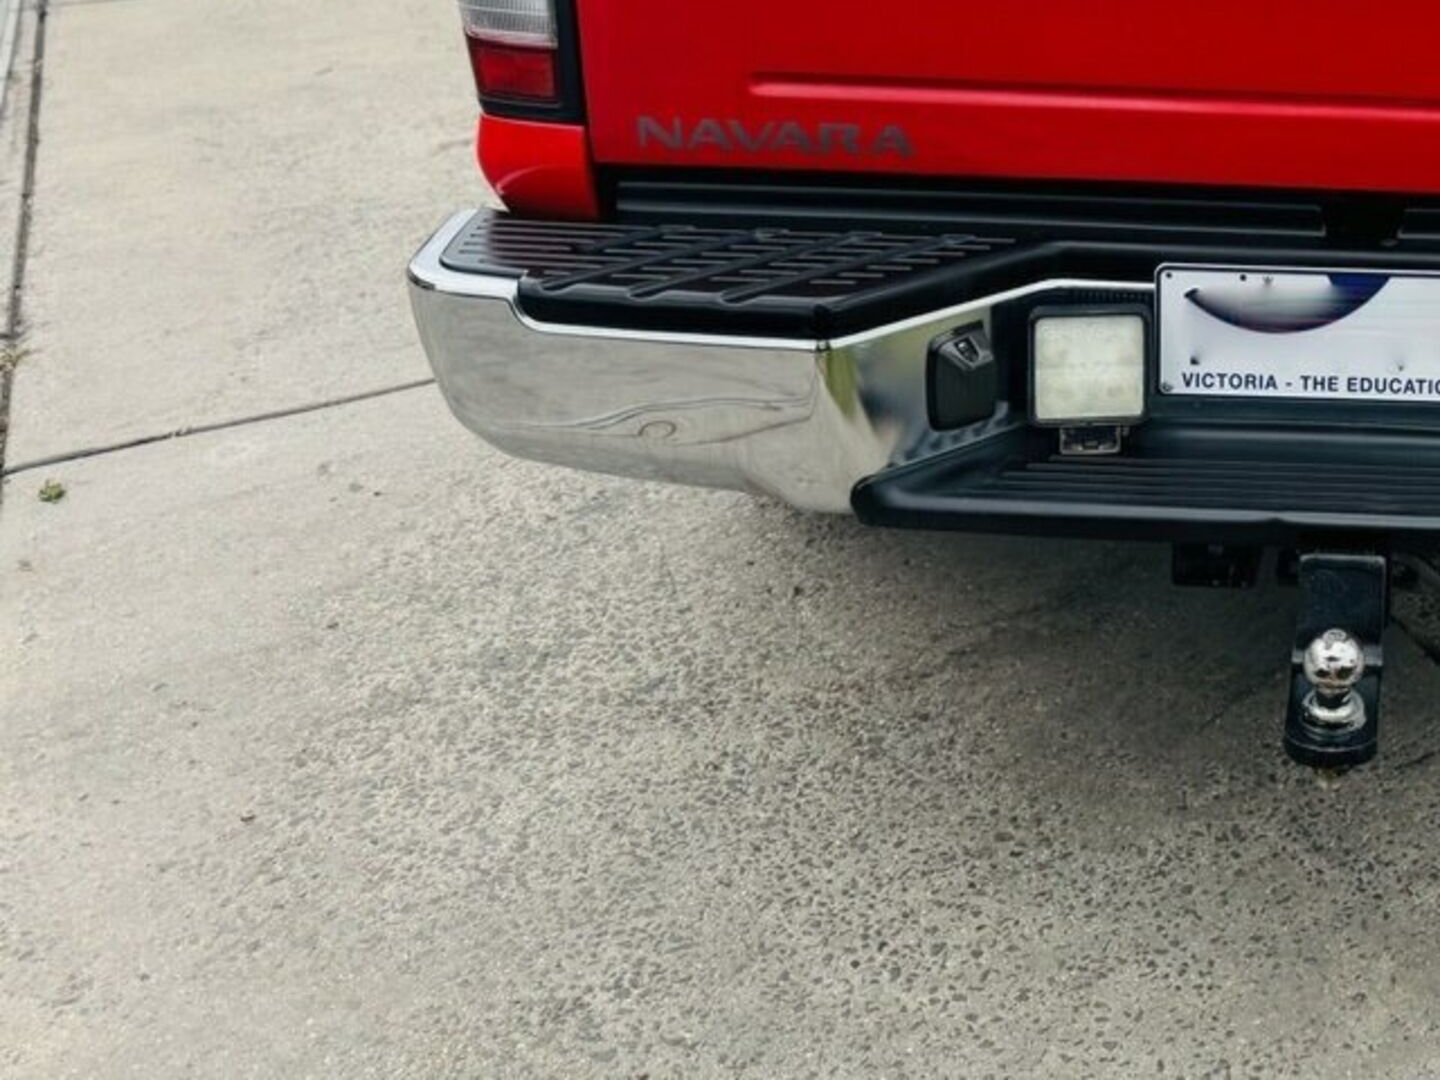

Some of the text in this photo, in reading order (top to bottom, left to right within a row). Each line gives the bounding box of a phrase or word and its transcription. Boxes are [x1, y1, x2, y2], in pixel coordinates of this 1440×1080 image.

[636, 115, 913, 157] NAVARA
[1182, 372, 1278, 391] VICTORIA
[1300, 375, 1340, 393] THE
